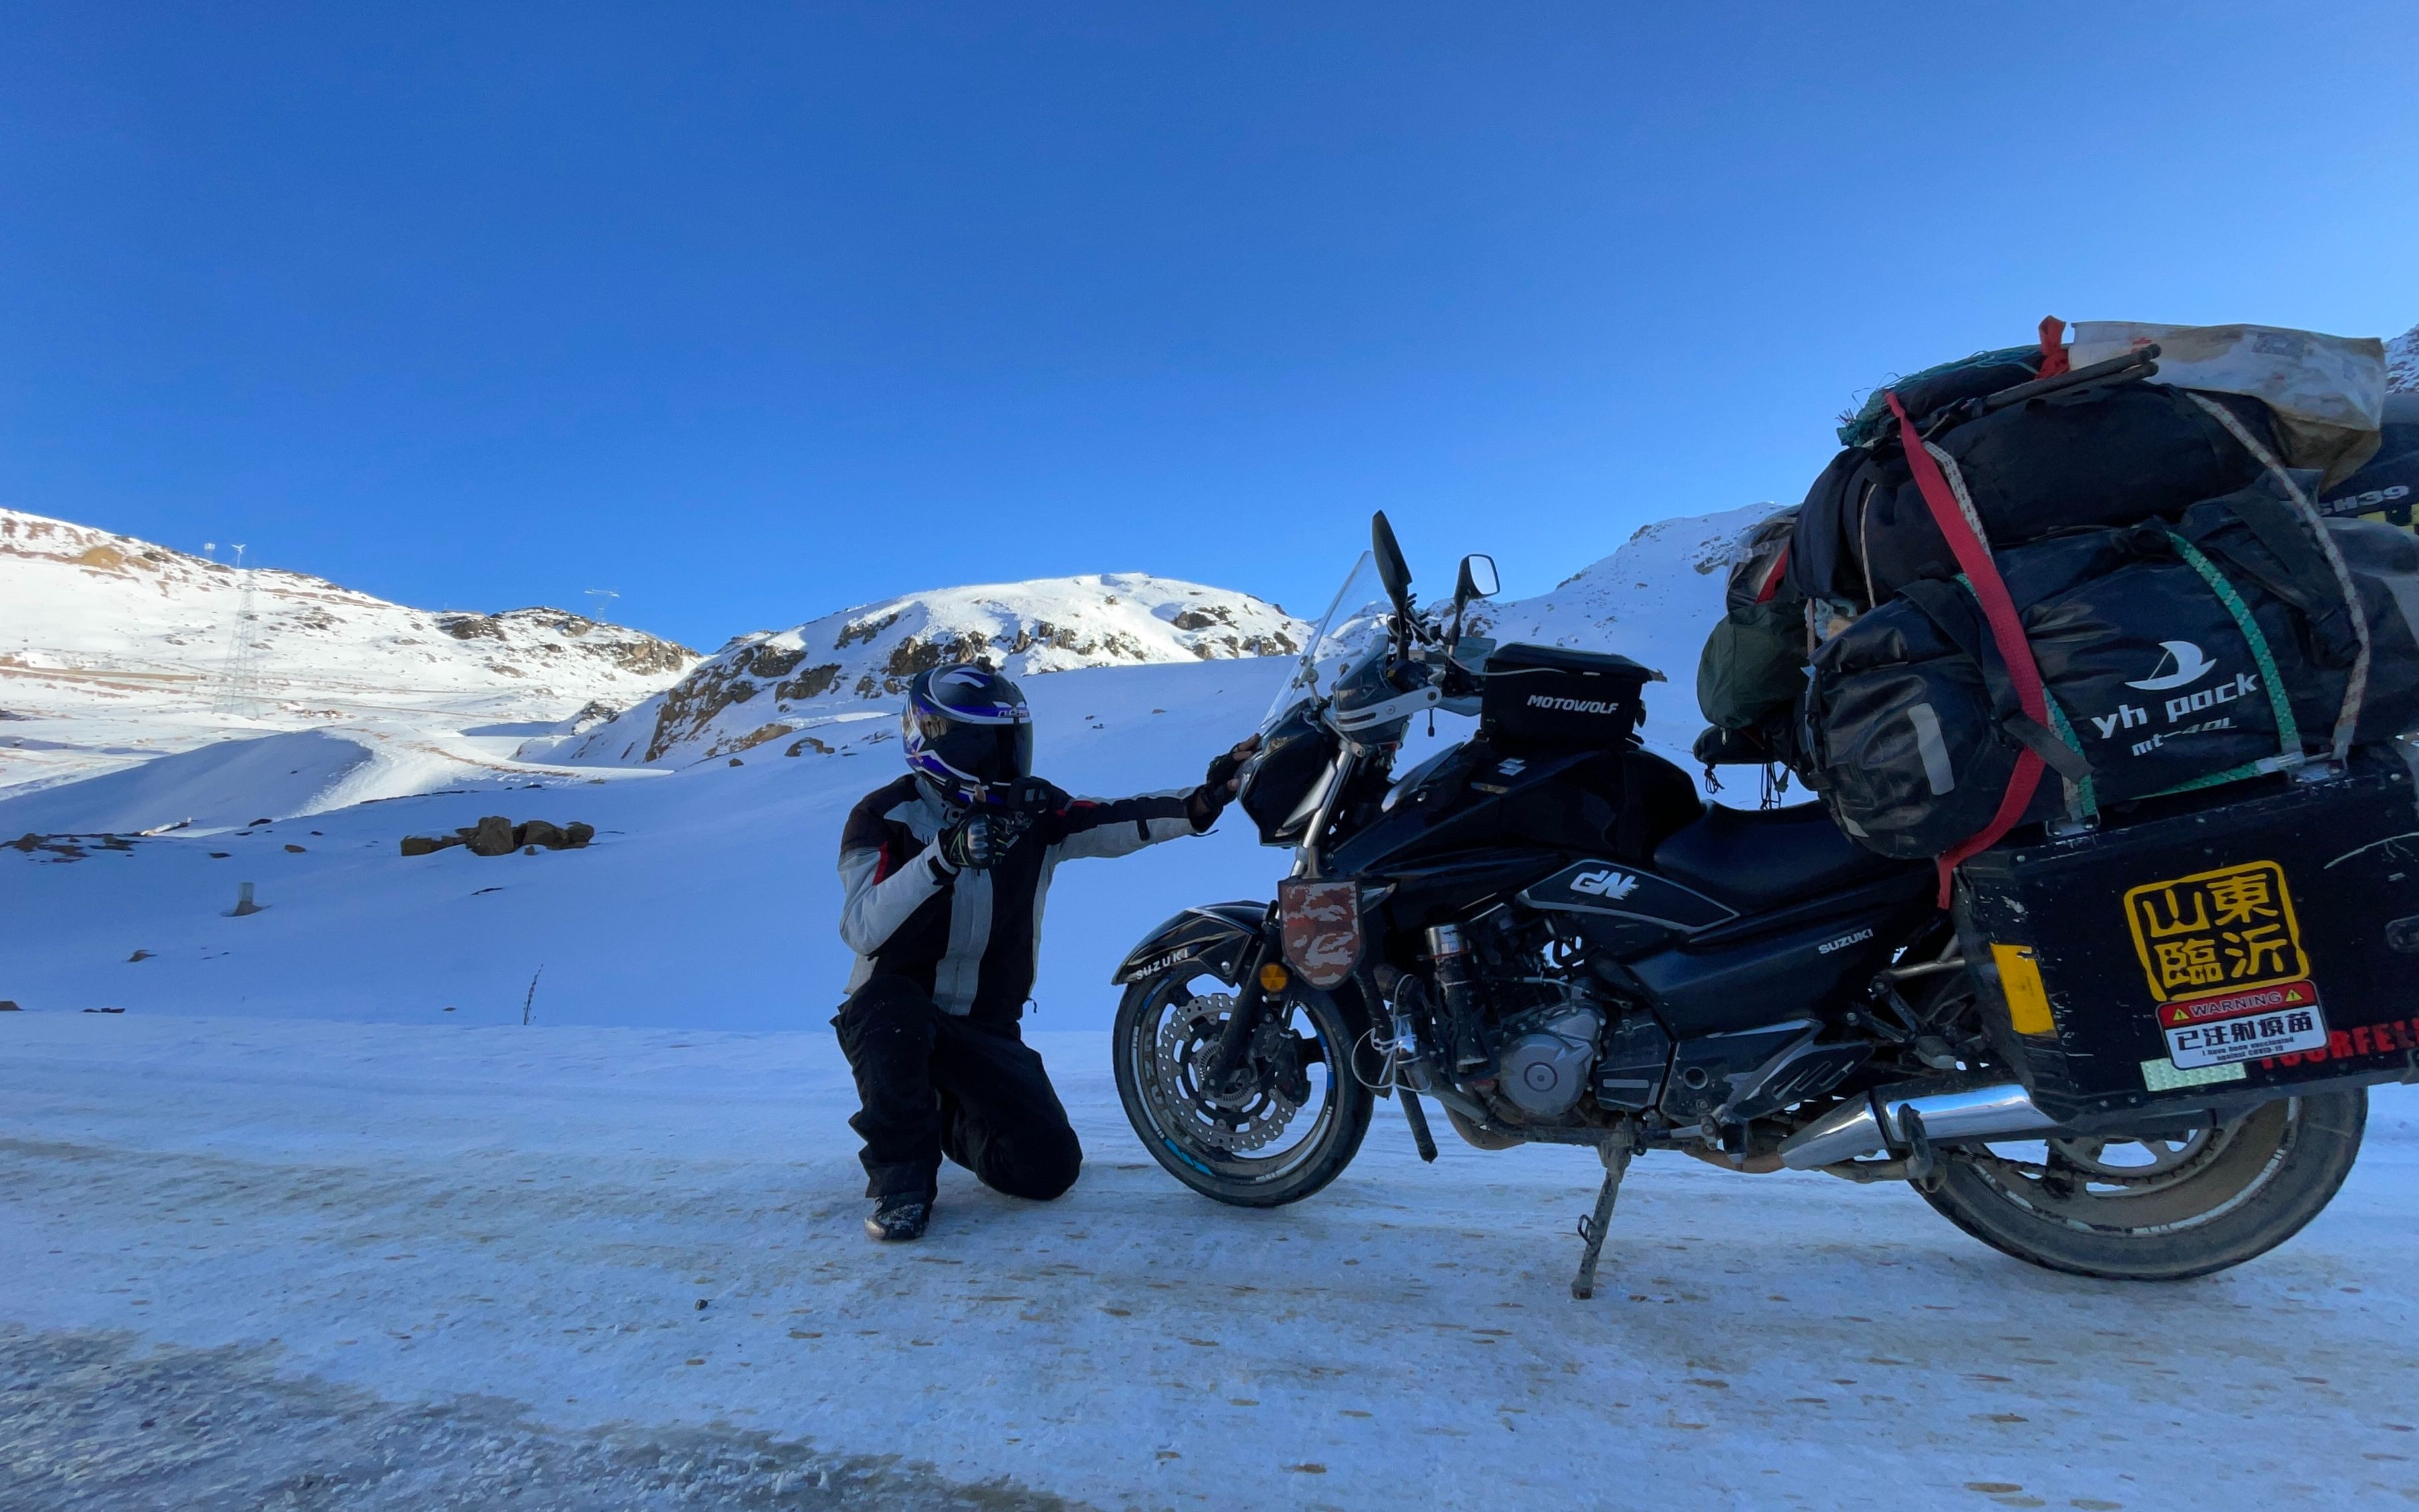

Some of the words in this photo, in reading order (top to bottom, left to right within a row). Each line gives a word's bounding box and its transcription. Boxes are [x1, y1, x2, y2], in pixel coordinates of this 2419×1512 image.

[1527, 695, 1619, 714] MOTOWOLF
[2091, 704, 2148, 739] yh
[1818, 928, 1874, 955] SUZUKI
[1135, 949, 1188, 980] SUZUKI
[2189, 991, 2282, 1017] WARNING
[2174, 1011, 2314, 1051] 已注射疫苗
[2250, 1037, 2294, 1047] vaccinated
[2216, 1051, 2246, 1061] against
